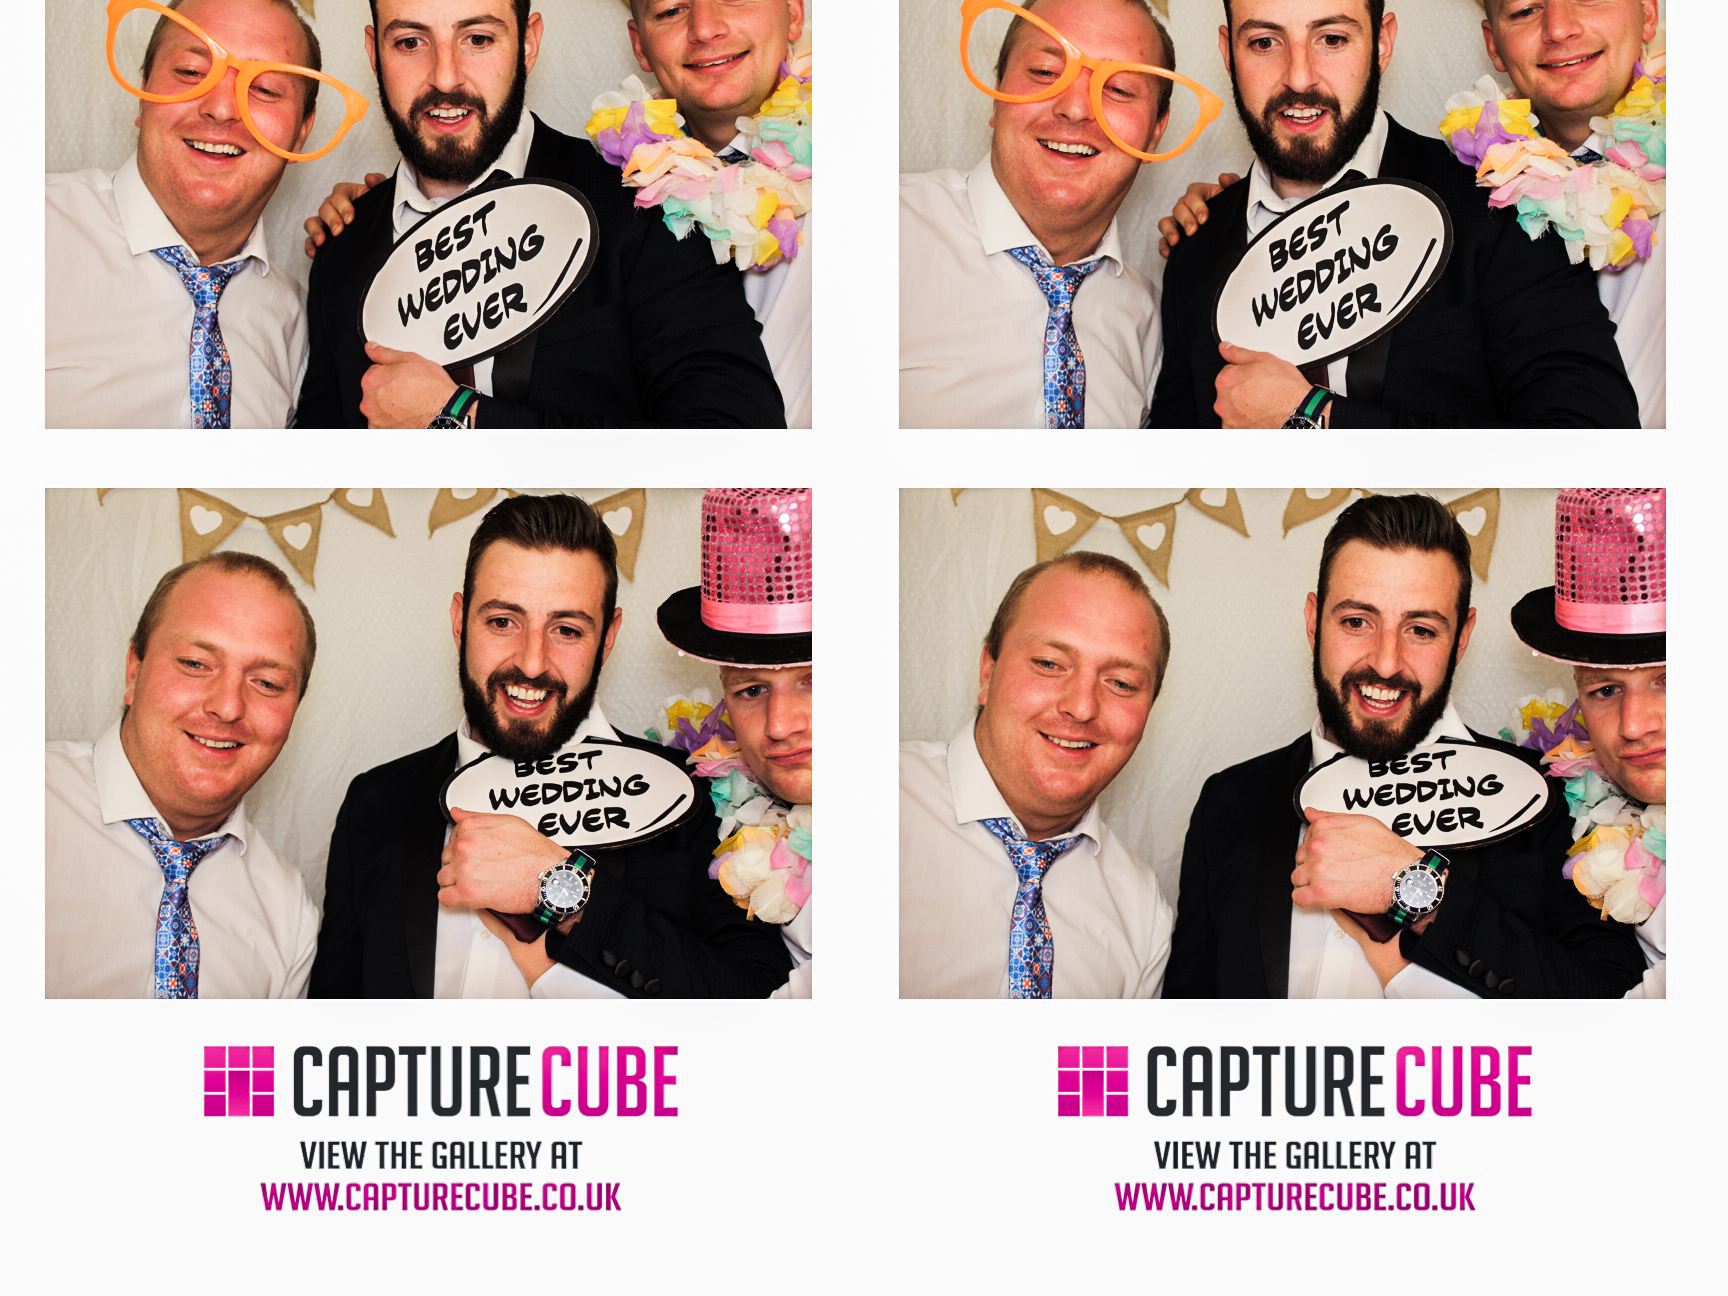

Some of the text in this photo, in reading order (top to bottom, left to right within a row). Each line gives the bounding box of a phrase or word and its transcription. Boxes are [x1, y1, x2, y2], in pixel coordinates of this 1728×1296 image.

[414, 200, 497, 273] BEST
[1268, 200, 1351, 273] BEST
[397, 223, 545, 328] WEDDING
[1251, 223, 1399, 328] WEDDING
[443, 282, 528, 351] EVER
[1297, 282, 1382, 351] EVER
[513, 749, 603, 778] BEST
[1367, 749, 1457, 778] BEST
[488, 773, 651, 811] WEDDING
[1342, 773, 1505, 811] WEDDING
[537, 806, 630, 838] EVER
[1391, 806, 1484, 838] EVER
